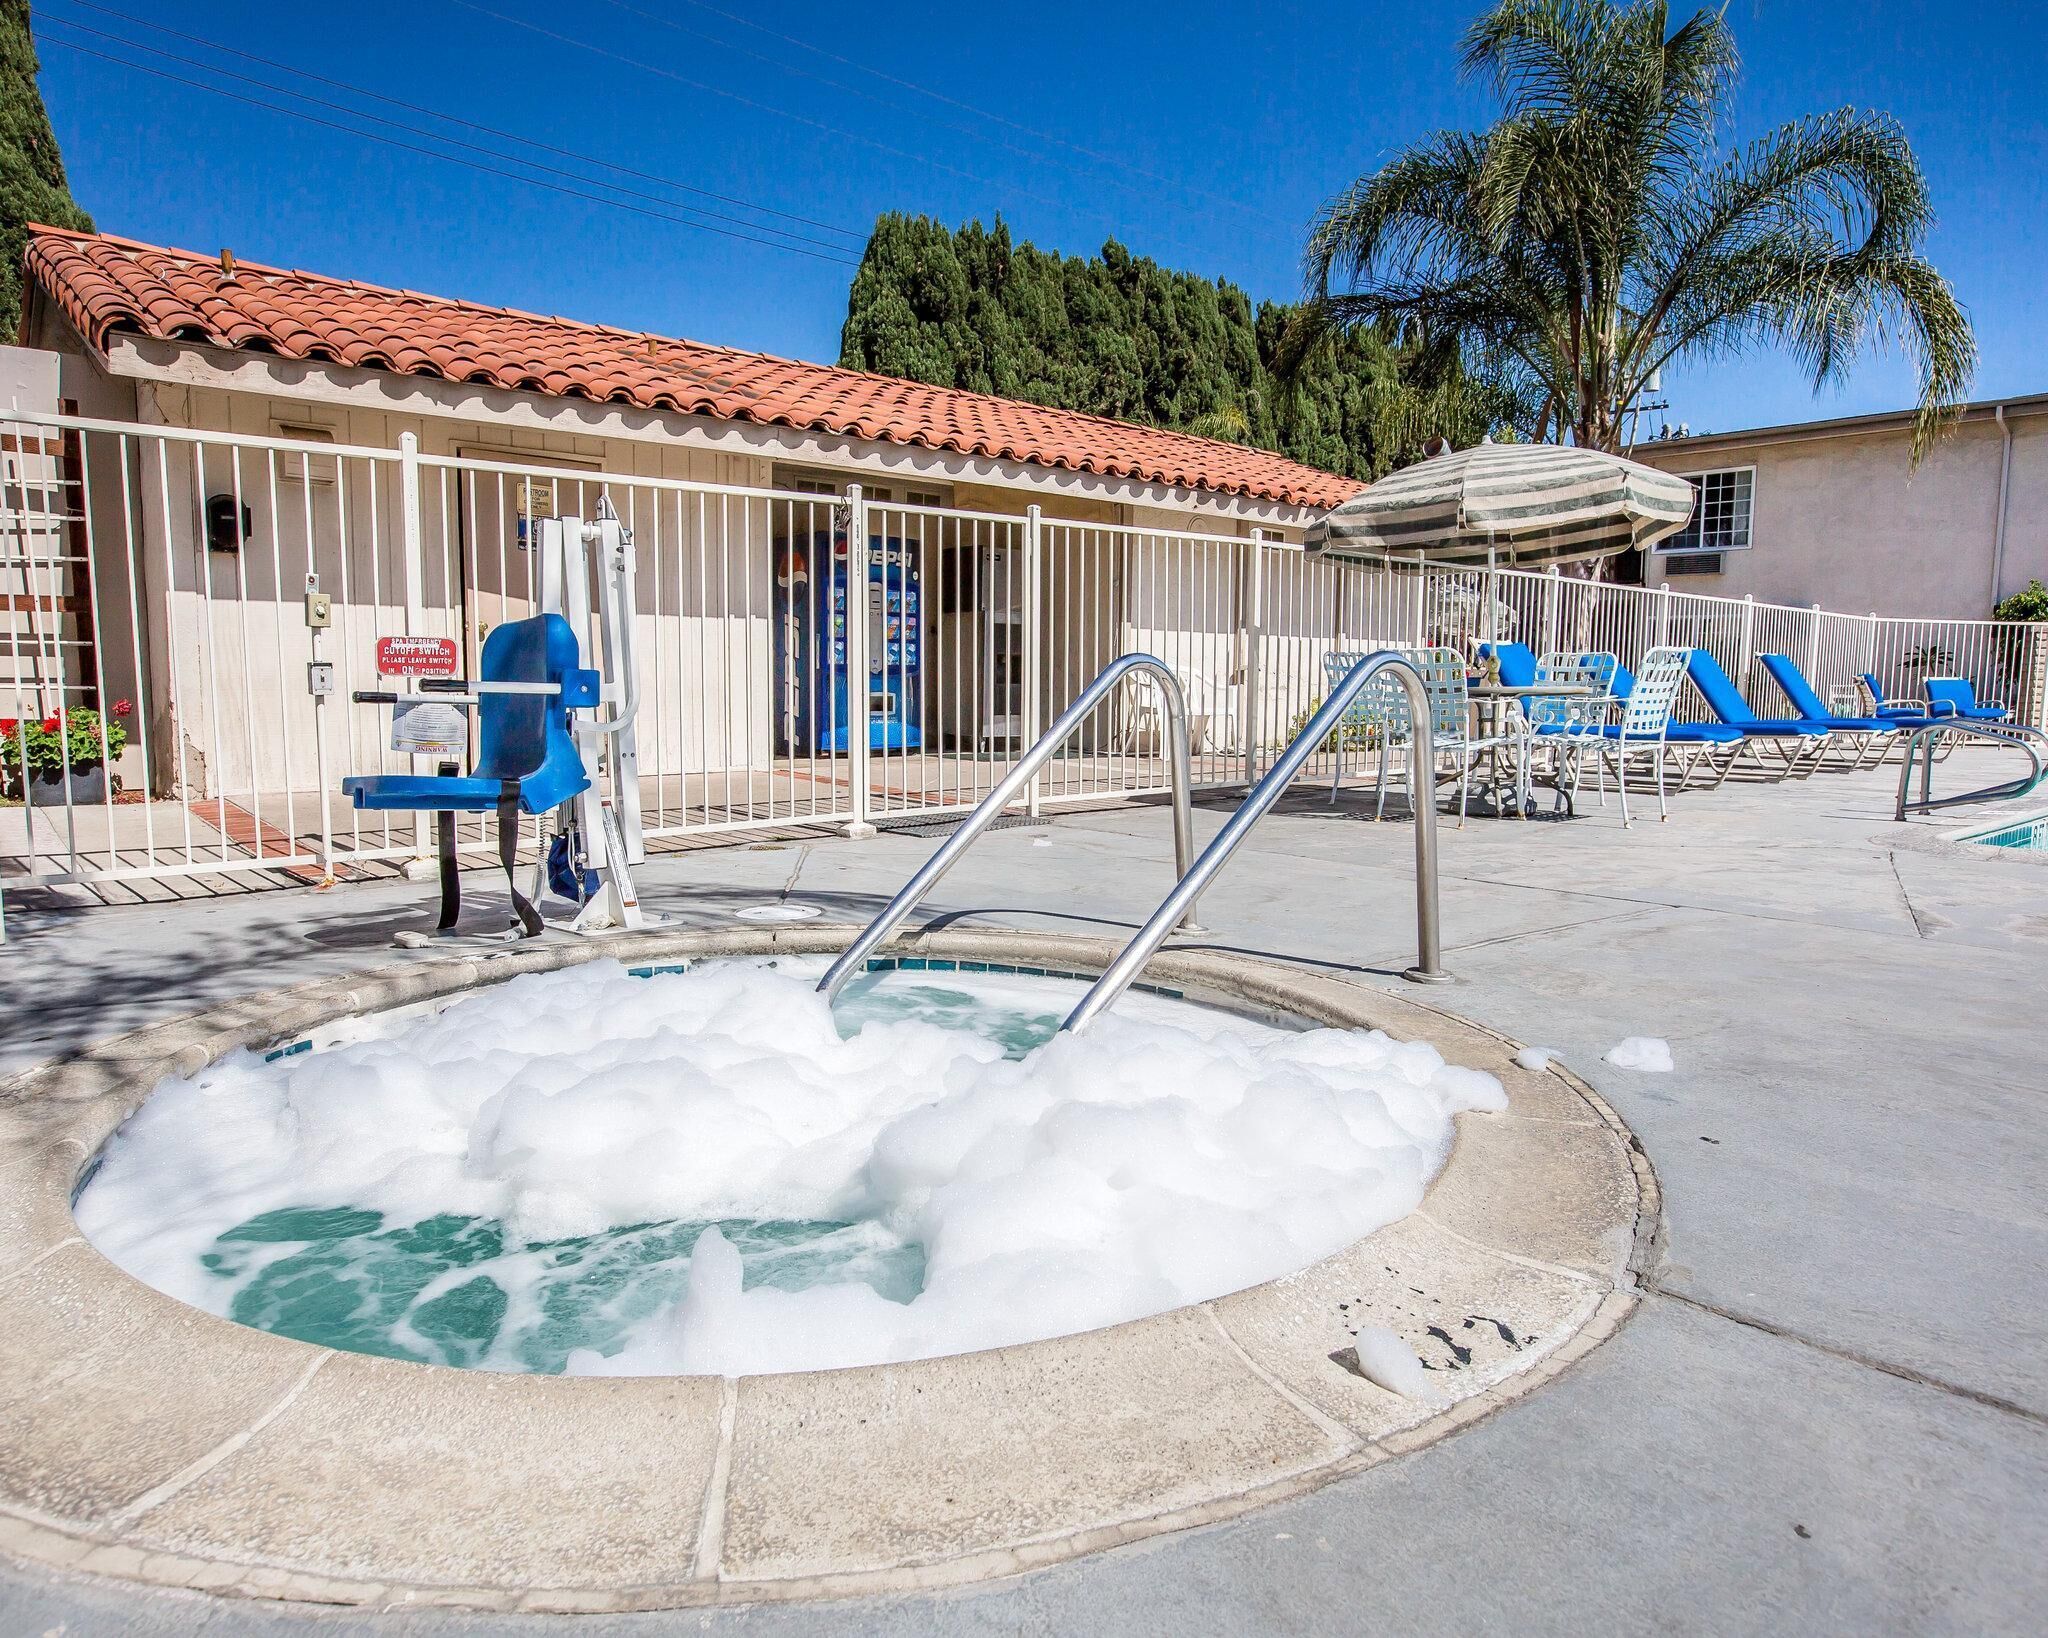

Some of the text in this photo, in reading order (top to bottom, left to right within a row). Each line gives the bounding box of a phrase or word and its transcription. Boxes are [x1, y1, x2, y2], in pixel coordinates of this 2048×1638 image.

[384, 647, 450, 656] CUTOFF SWITCH
[382, 656, 406, 664] PLEASE
[428, 657, 453, 665] SWITCH
[402, 665, 414, 675] ON
[421, 667, 450, 675] POSITION
[415, 745, 449, 753] WARNING
